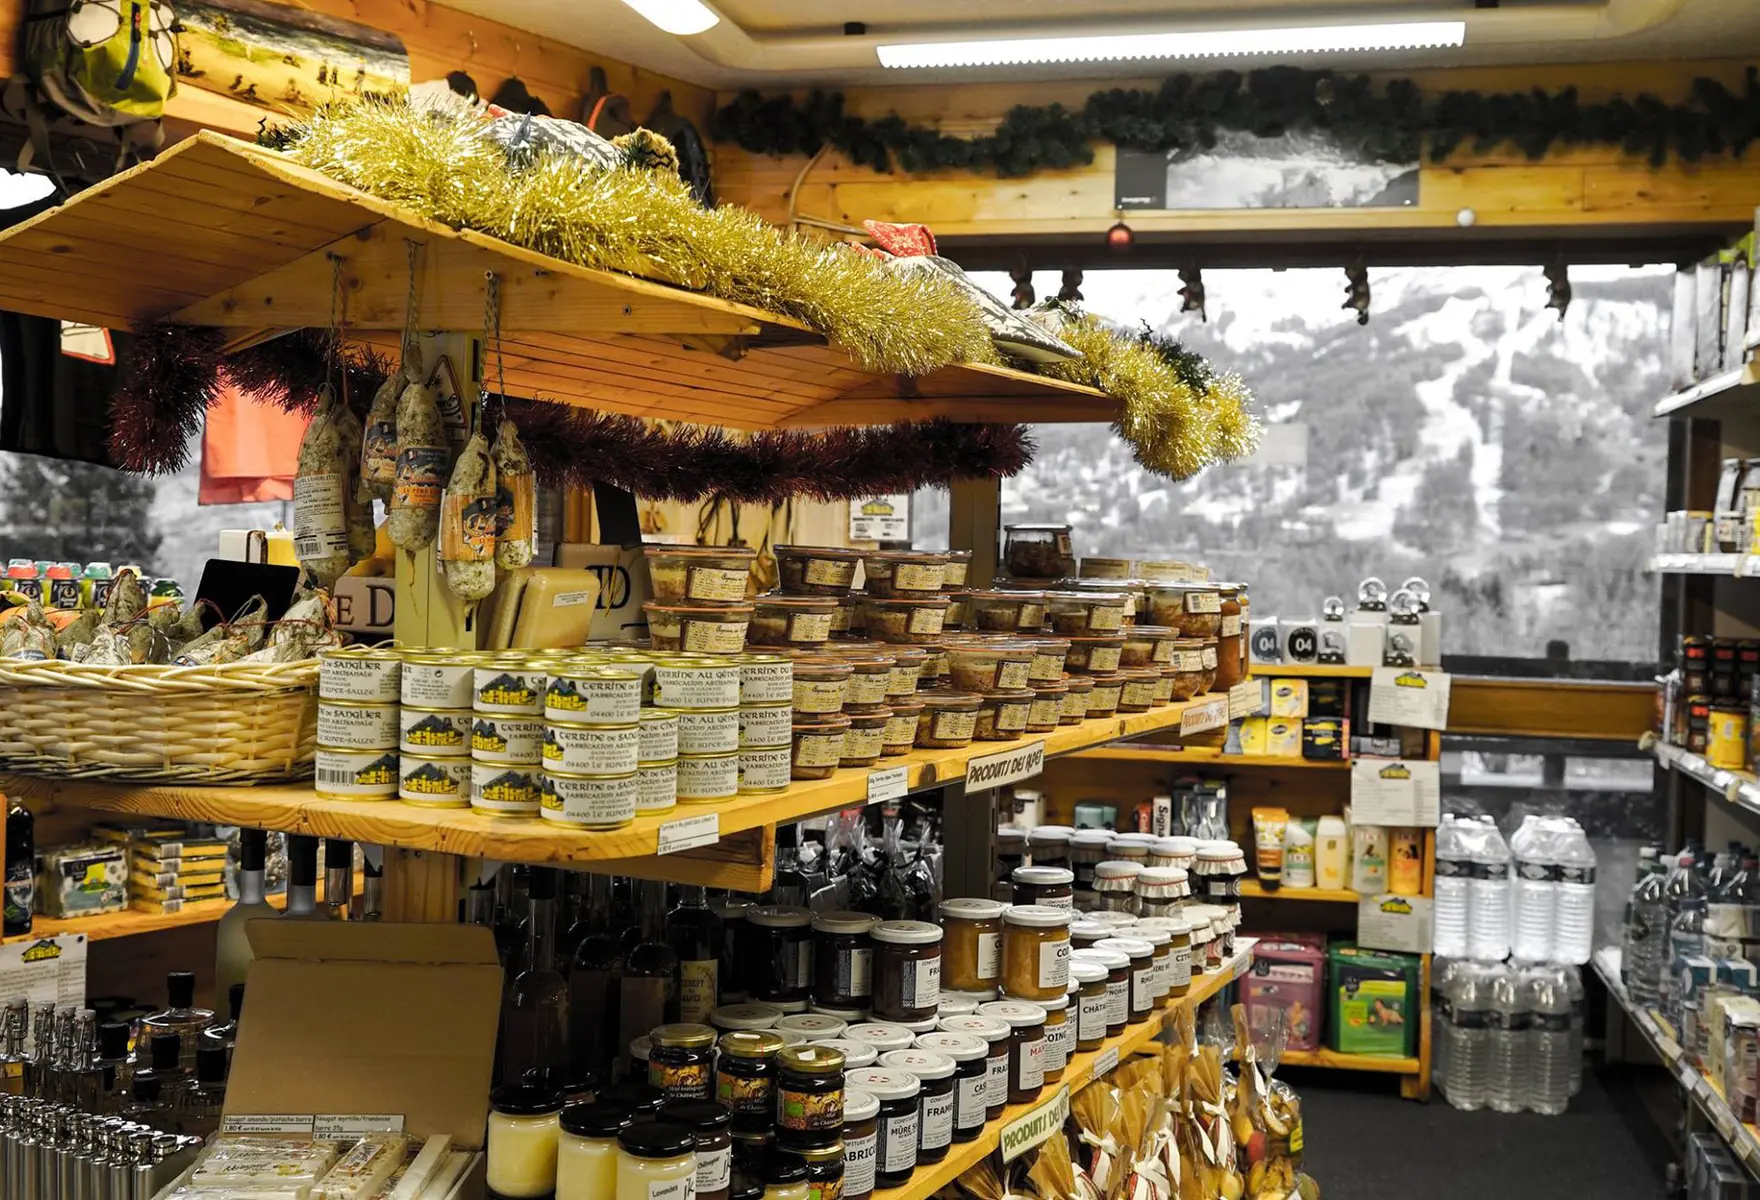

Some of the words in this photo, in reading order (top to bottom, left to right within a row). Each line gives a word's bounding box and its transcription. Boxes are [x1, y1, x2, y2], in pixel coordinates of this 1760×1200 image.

[1260, 637, 1275, 652] 04
[1295, 637, 1312, 652] 04
[697, 671, 713, 679] AU
[582, 681, 628, 691] TERRINE
[699, 716, 715, 724] AU
[559, 731, 605, 741] TERRINE
[703, 761, 718, 769] AU
[968, 759, 1011, 784] PRODUITS
[558, 781, 605, 791] TERRINE
[225, 1115, 246, 1124] Nougat
[890, 1126, 911, 1136] MÛRE
[1003, 1113, 1046, 1153] PRODUITS
